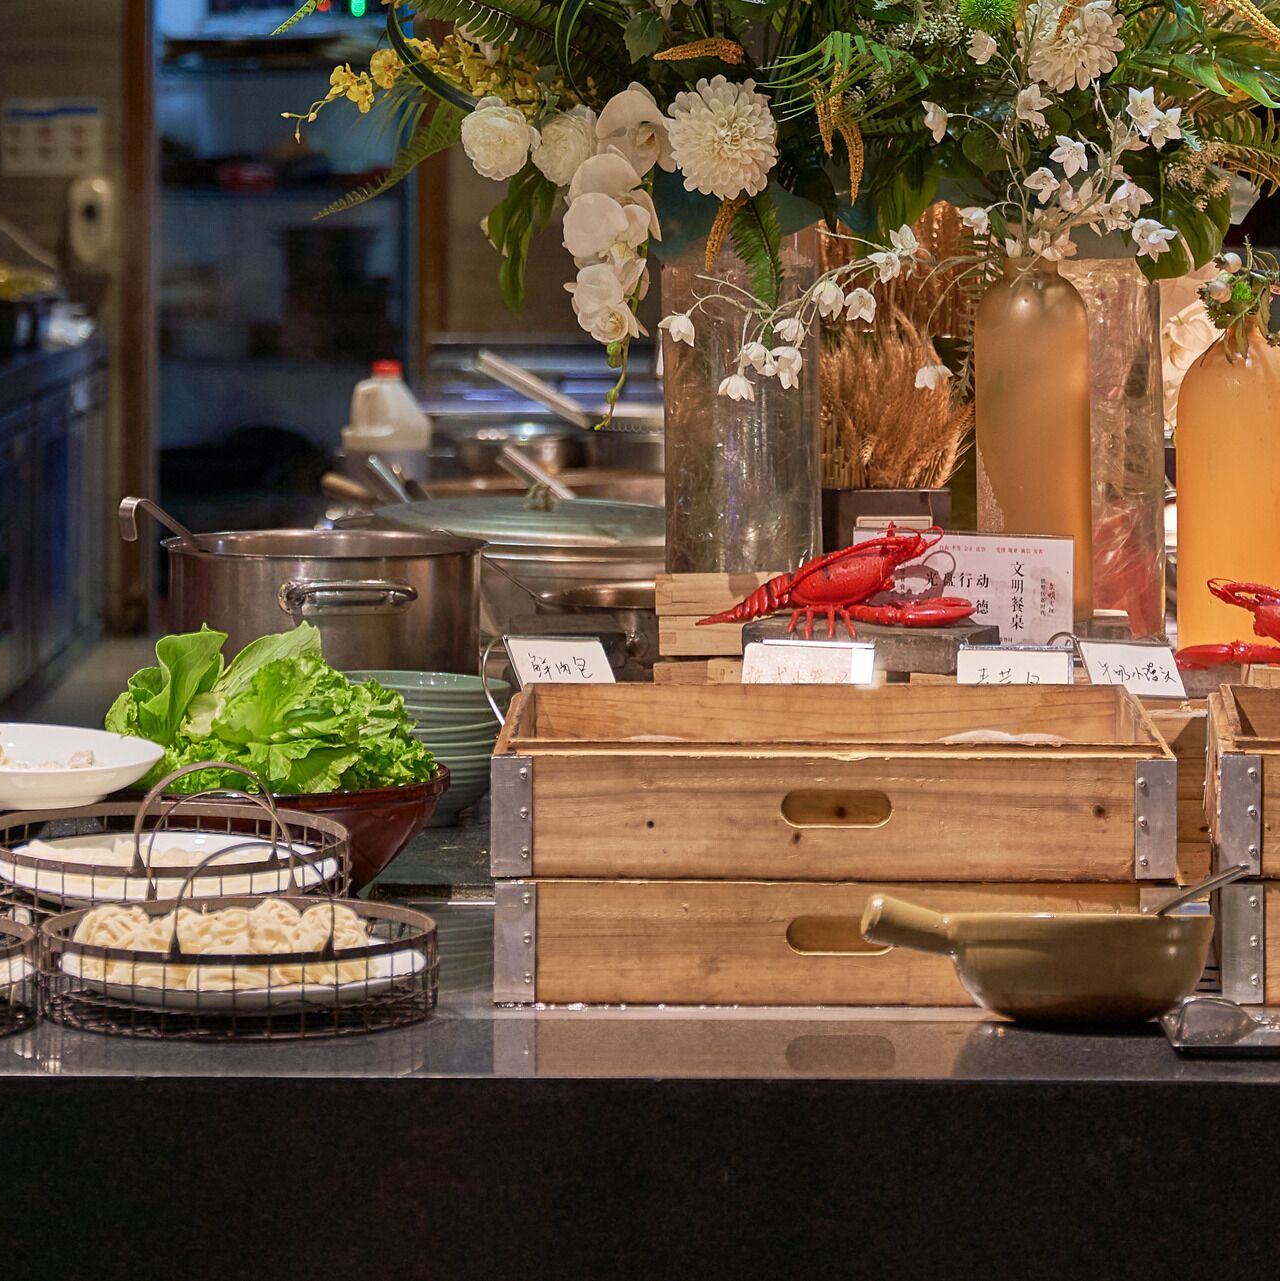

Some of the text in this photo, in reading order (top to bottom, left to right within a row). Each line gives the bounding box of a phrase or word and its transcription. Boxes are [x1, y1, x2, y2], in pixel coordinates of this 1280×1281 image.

[926, 572, 989, 589] 光盘行动
[1009, 560, 1025, 630] 文明餐桌
